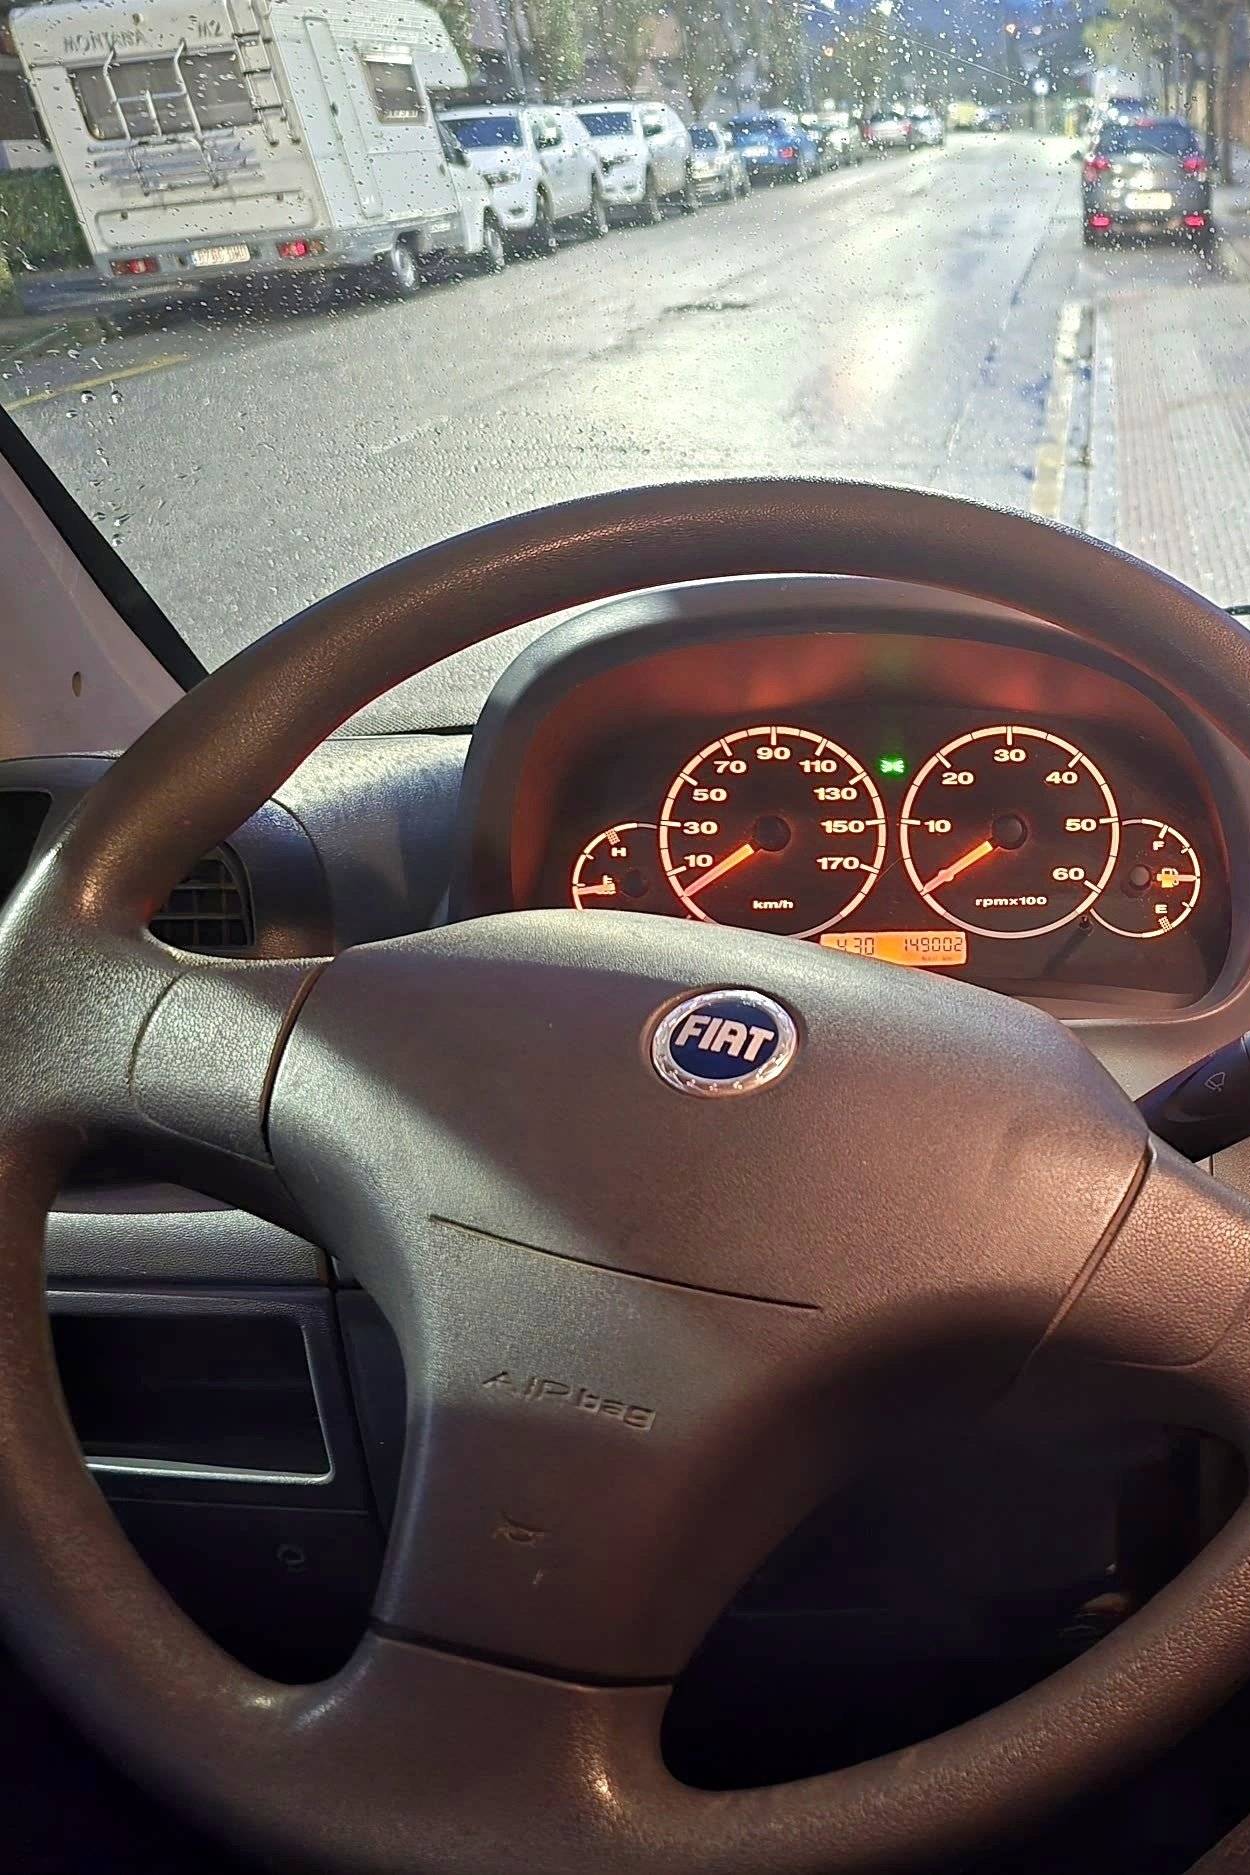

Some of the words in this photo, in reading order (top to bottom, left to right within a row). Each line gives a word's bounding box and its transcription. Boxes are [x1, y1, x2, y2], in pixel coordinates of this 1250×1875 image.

[756, 747, 791, 760] 90
[993, 749, 1026, 762] 30
[713, 760, 747, 774] 70
[799, 760, 837, 773] 110
[941, 772, 974, 785] 20
[1045, 772, 1078, 785] 40
[692, 788, 727, 801] 50
[814, 787, 857, 800] 130
[683, 822, 718, 835] 30
[820, 820, 865, 833] 150
[924, 820, 951, 833] 10
[1065, 819, 1097, 832] 50
[1152, 841, 1165, 851] F
[685, 854, 713, 867] 10
[816, 857, 860, 870] 170
[1052, 868, 1085, 881] 60
[753, 900, 794, 910] km/h
[975, 896, 1047, 907] rpmx100
[1155, 904, 1168, 914] E
[905, 937, 963, 952] 149002
[675, 1014, 775, 1062] FIAT
